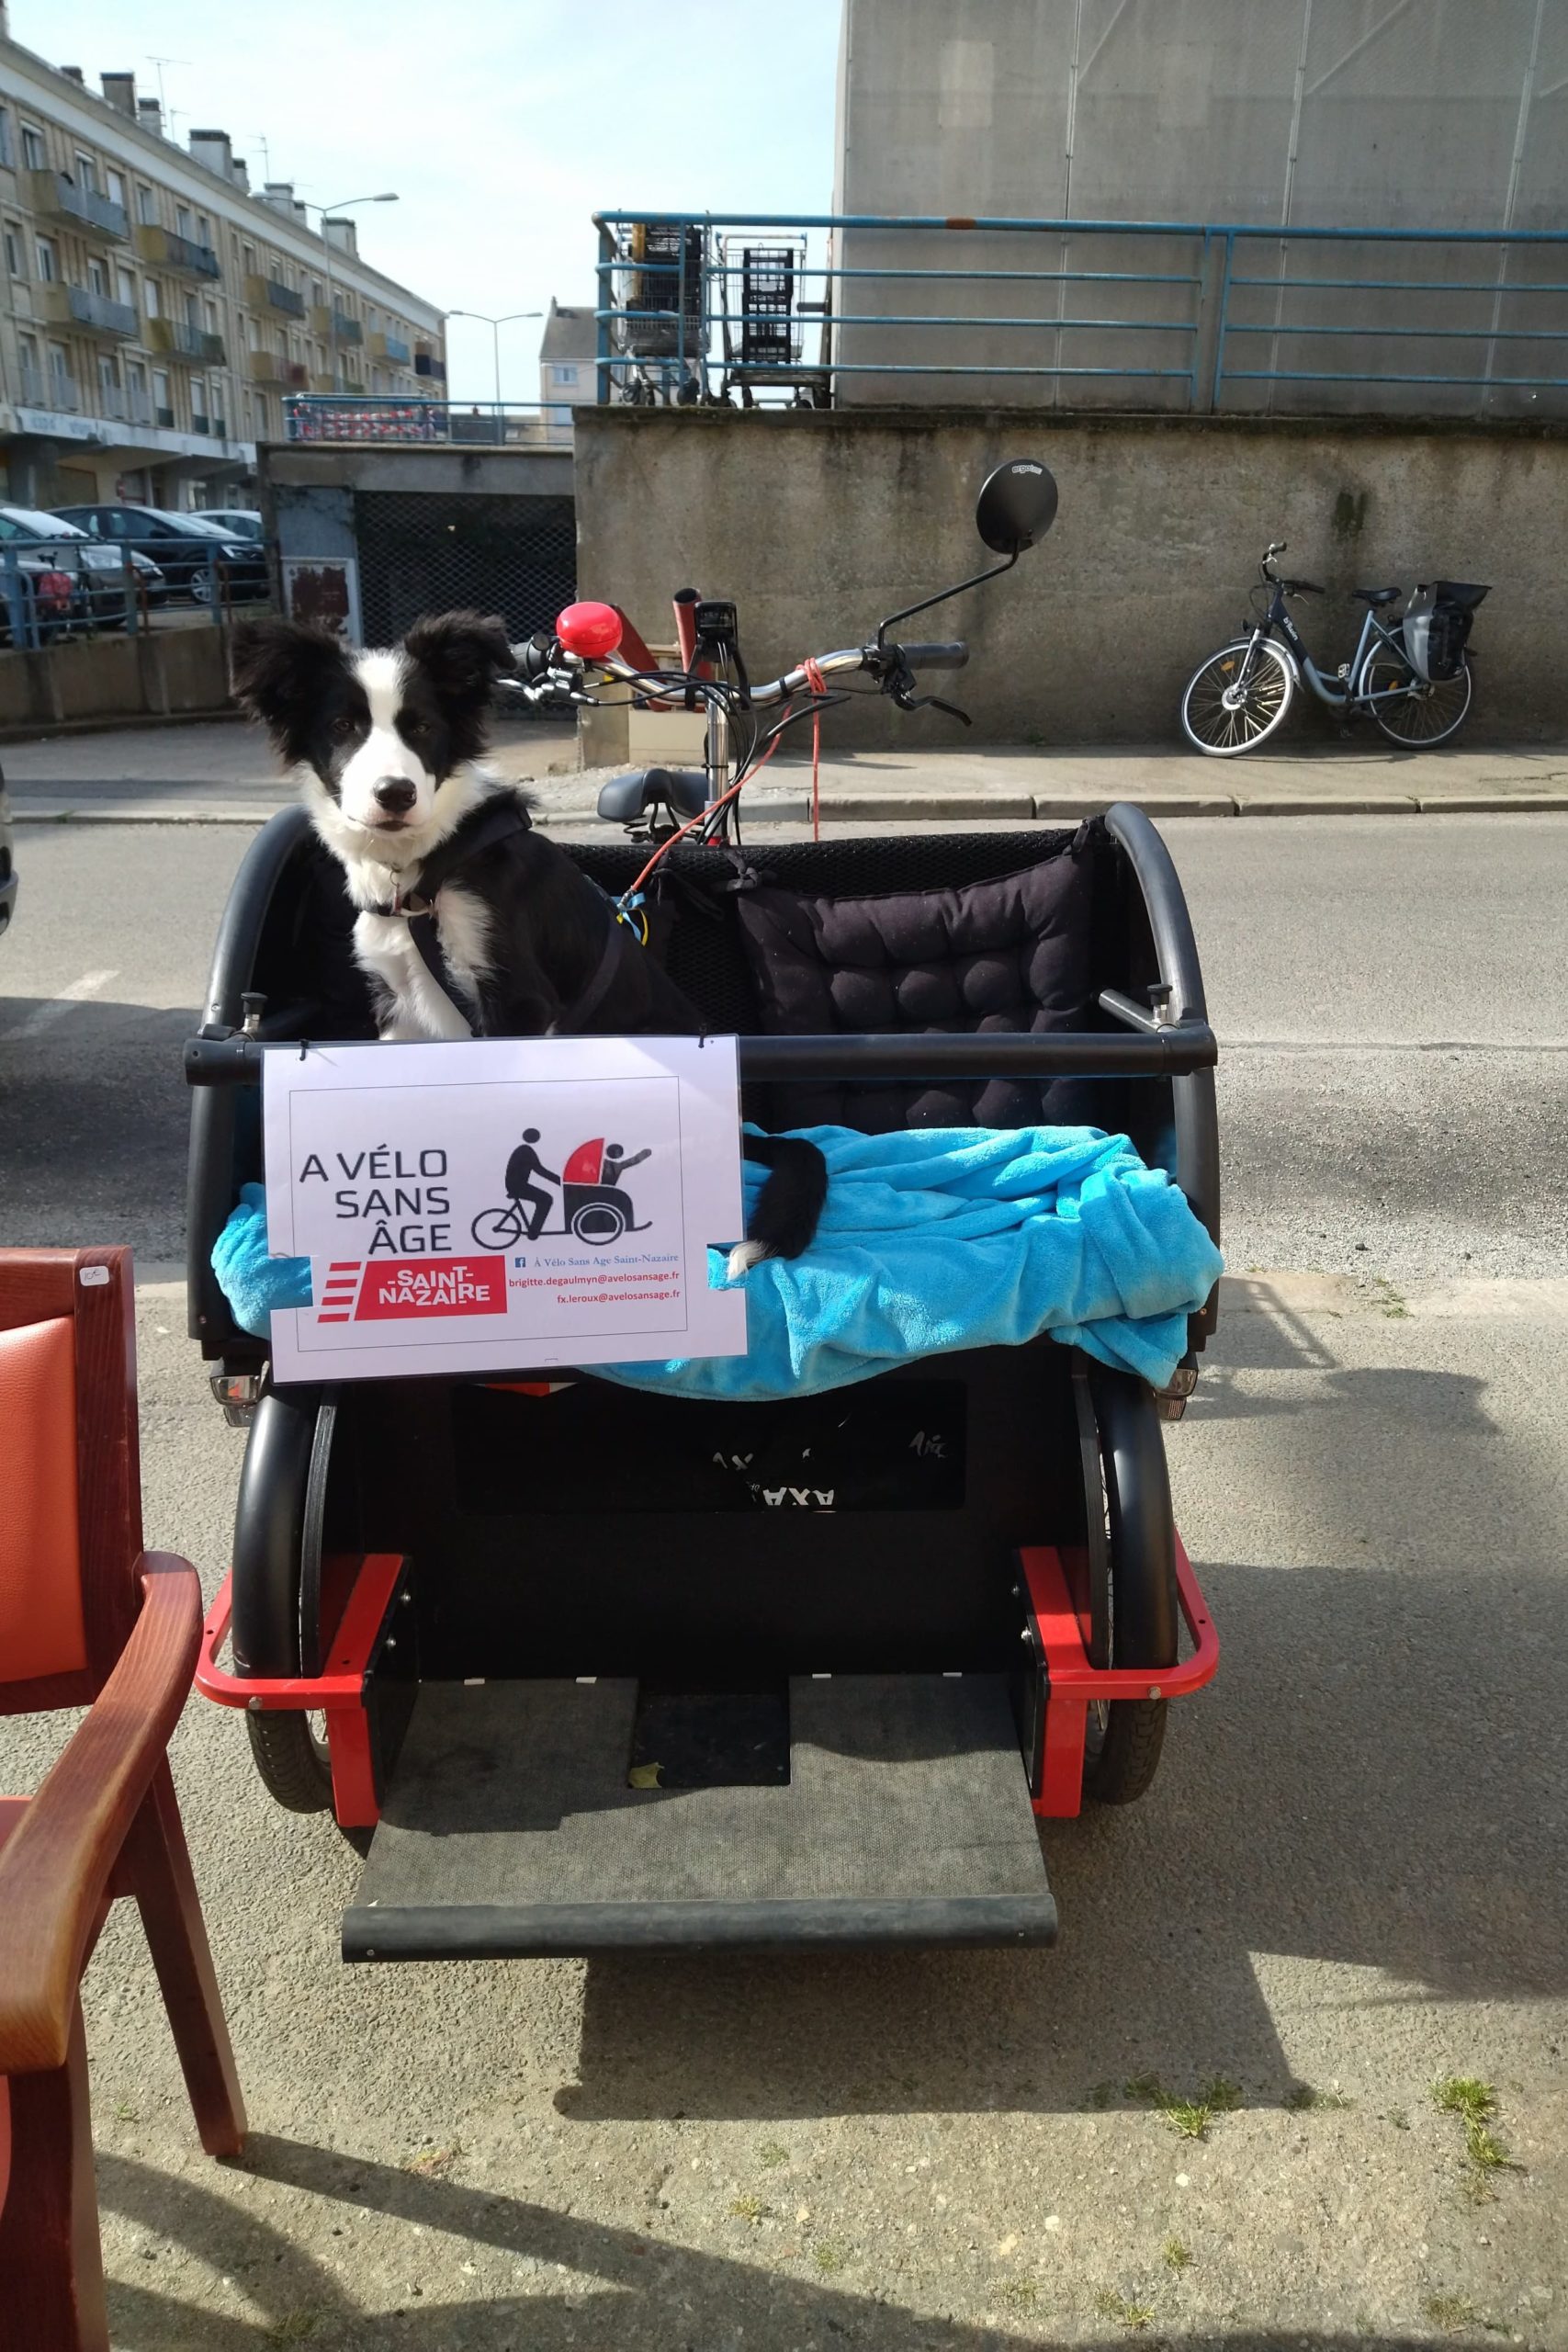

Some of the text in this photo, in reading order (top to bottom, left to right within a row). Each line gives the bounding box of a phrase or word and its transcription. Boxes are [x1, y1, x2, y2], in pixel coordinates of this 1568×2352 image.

[299, 1143, 447, 1183] A VÉLO
[335, 1186, 450, 1218] SANS
[367, 1219, 453, 1255] ÂGE
[545, 1257, 566, 1267] Vélo
[568, 1257, 590, 1266] Sans
[614, 1253, 679, 1264] Saint-Nazaire
[509, 1272, 680, 1288] brigitte.degaulmyn@avelosansage.fr
[378, 1283, 491, 1306] NAZAIRE
[557, 1290, 681, 1304] fx.leroux@avelosansage.fr
